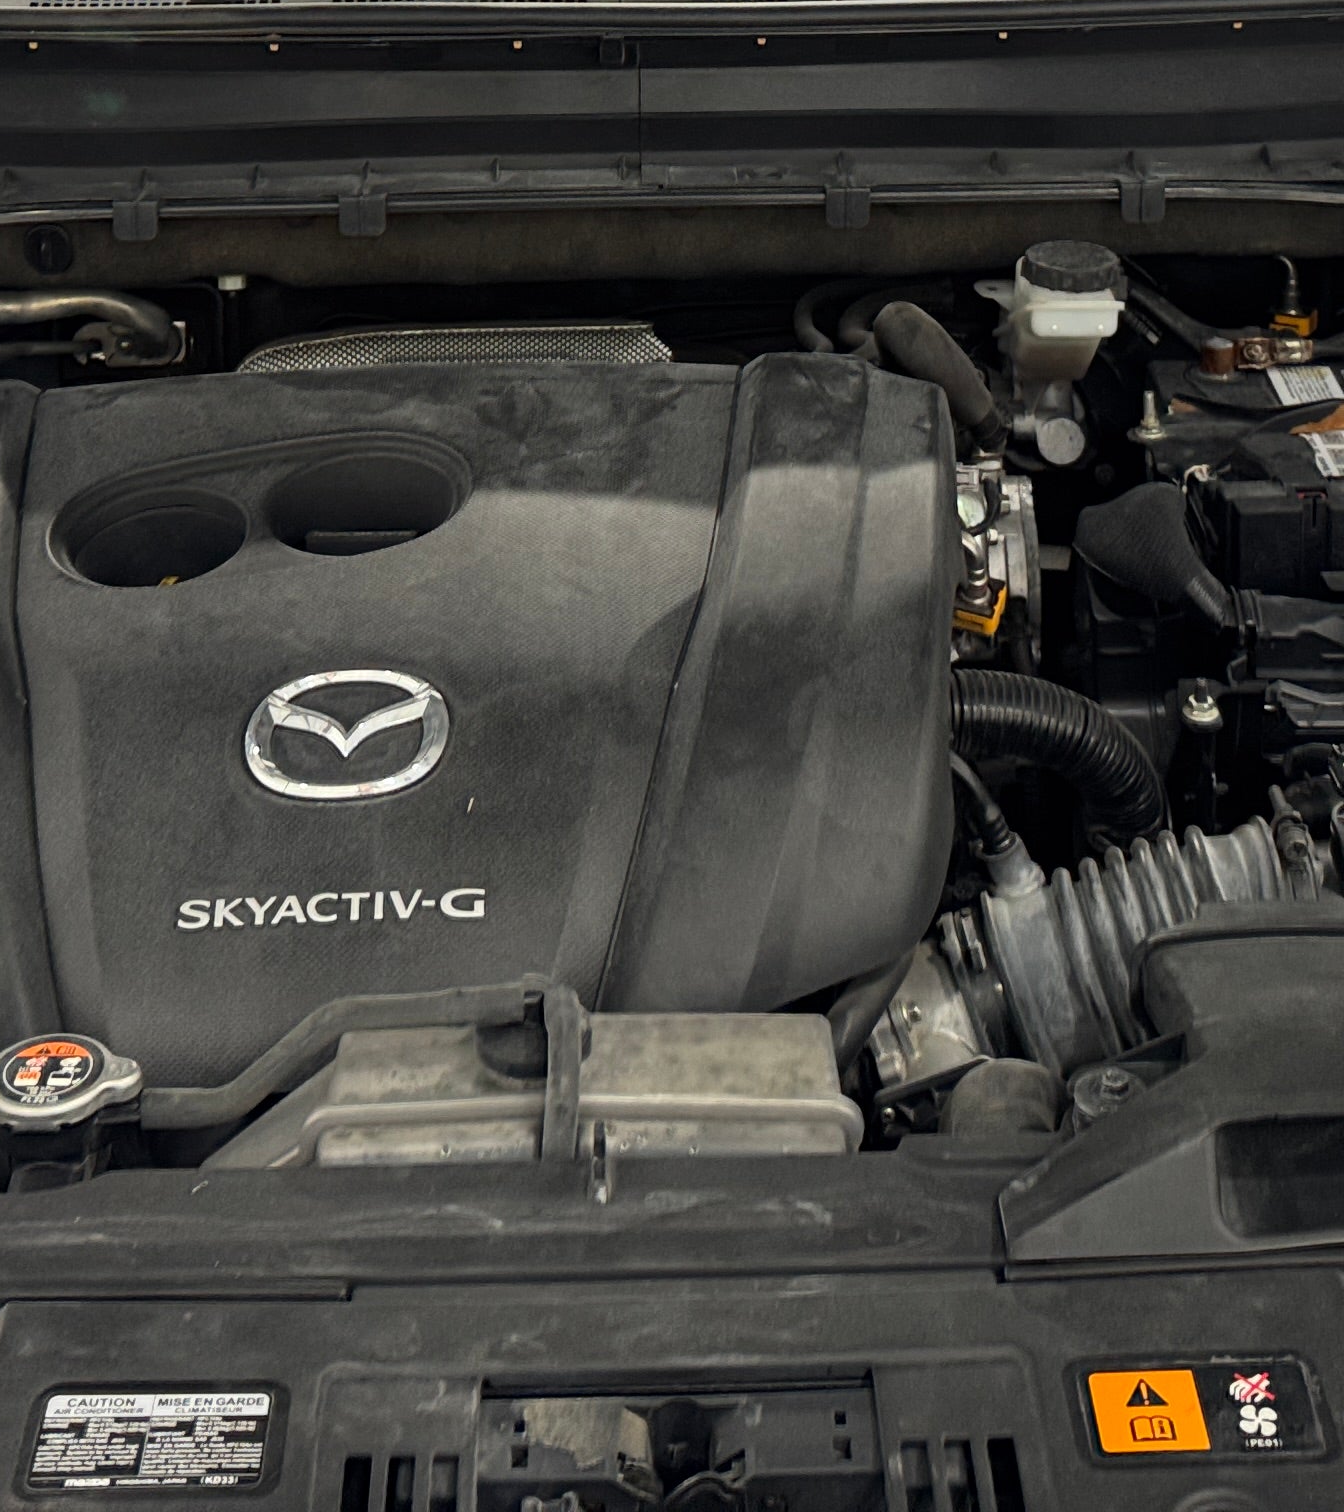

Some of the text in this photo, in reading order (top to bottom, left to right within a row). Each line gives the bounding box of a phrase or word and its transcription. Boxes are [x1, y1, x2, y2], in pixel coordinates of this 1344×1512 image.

[177, 888, 486, 929] SKYACTIV-G
[67, 1397, 137, 1407] CAUTION
[157, 1396, 264, 1407] MISE EN GARDE
[73, 1407, 144, 1415] CONDITIONER
